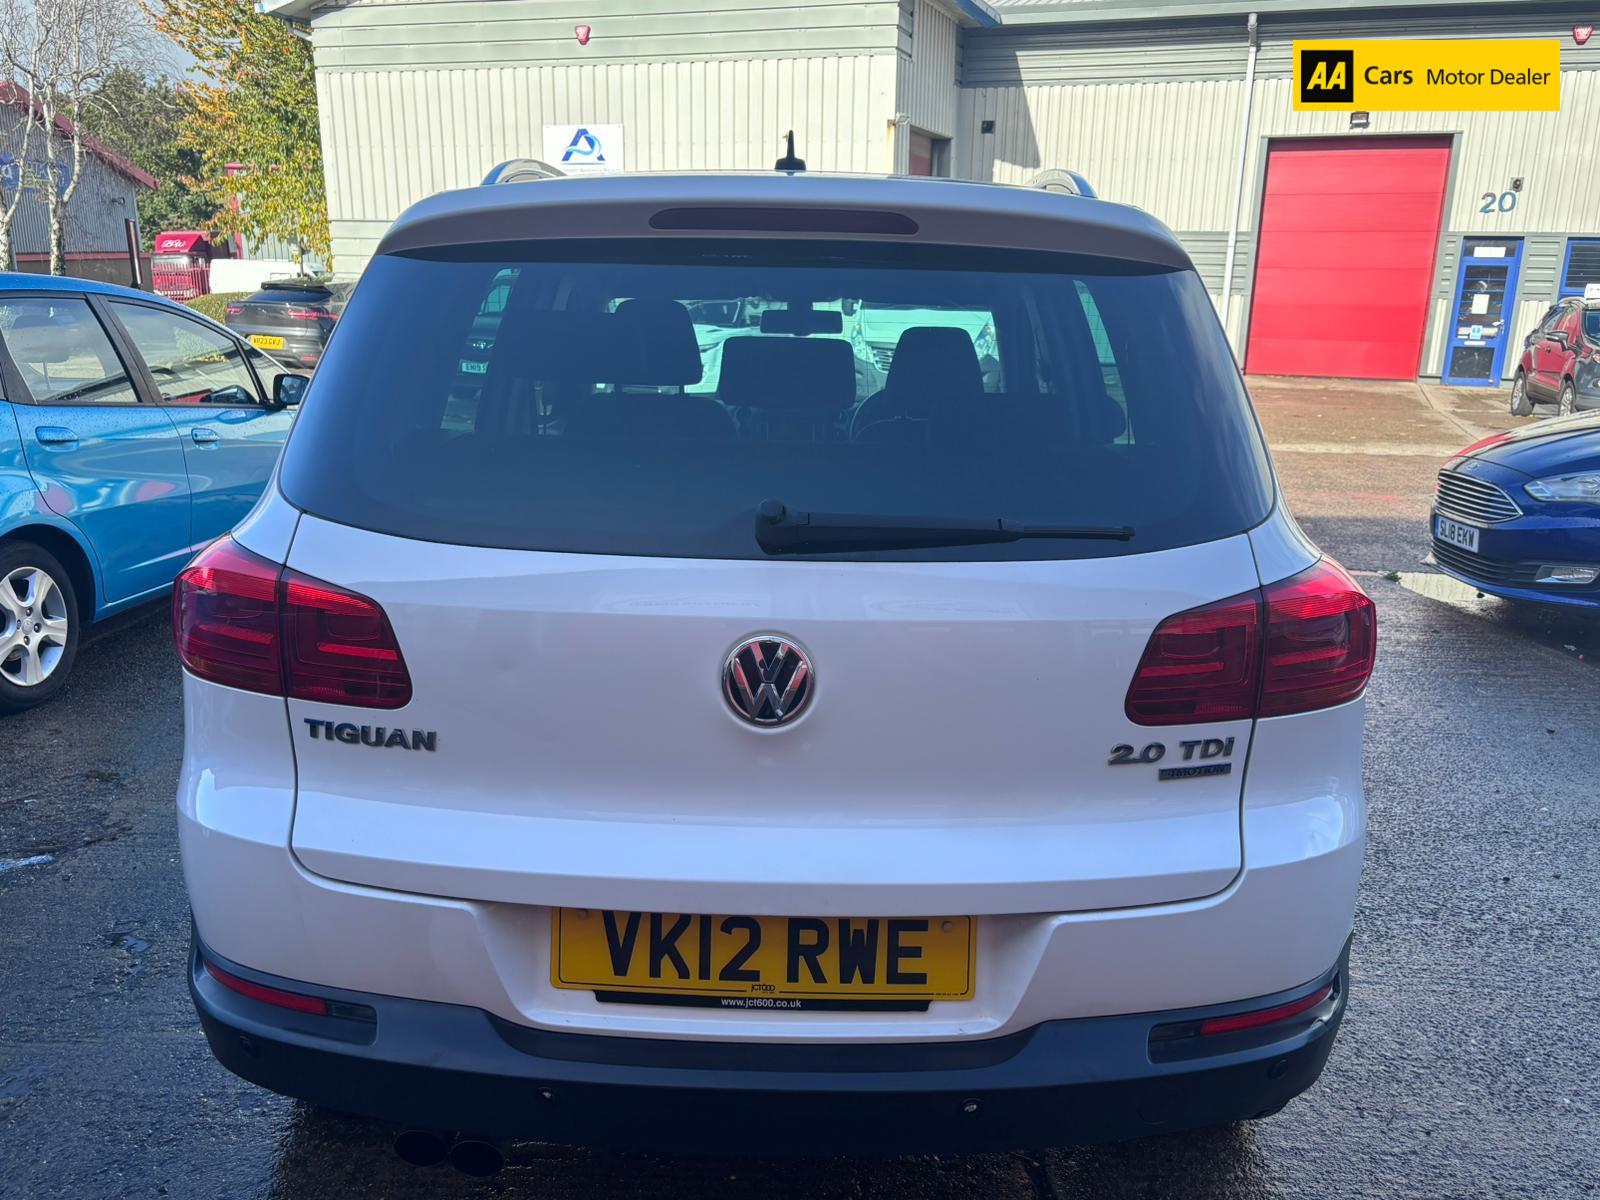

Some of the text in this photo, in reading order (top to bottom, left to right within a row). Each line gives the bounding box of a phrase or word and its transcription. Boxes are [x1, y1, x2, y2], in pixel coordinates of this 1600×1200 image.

[1479, 191, 1517, 213] 20
[1439, 518, 1455, 541] SL18
[728, 640, 808, 721] VW
[303, 717, 437, 752] TIGUAN
[1179, 736, 1236, 761] TDI
[602, 910, 928, 985] VK12 RWE
[720, 997, 802, 1009] www.jct600.co.uk
